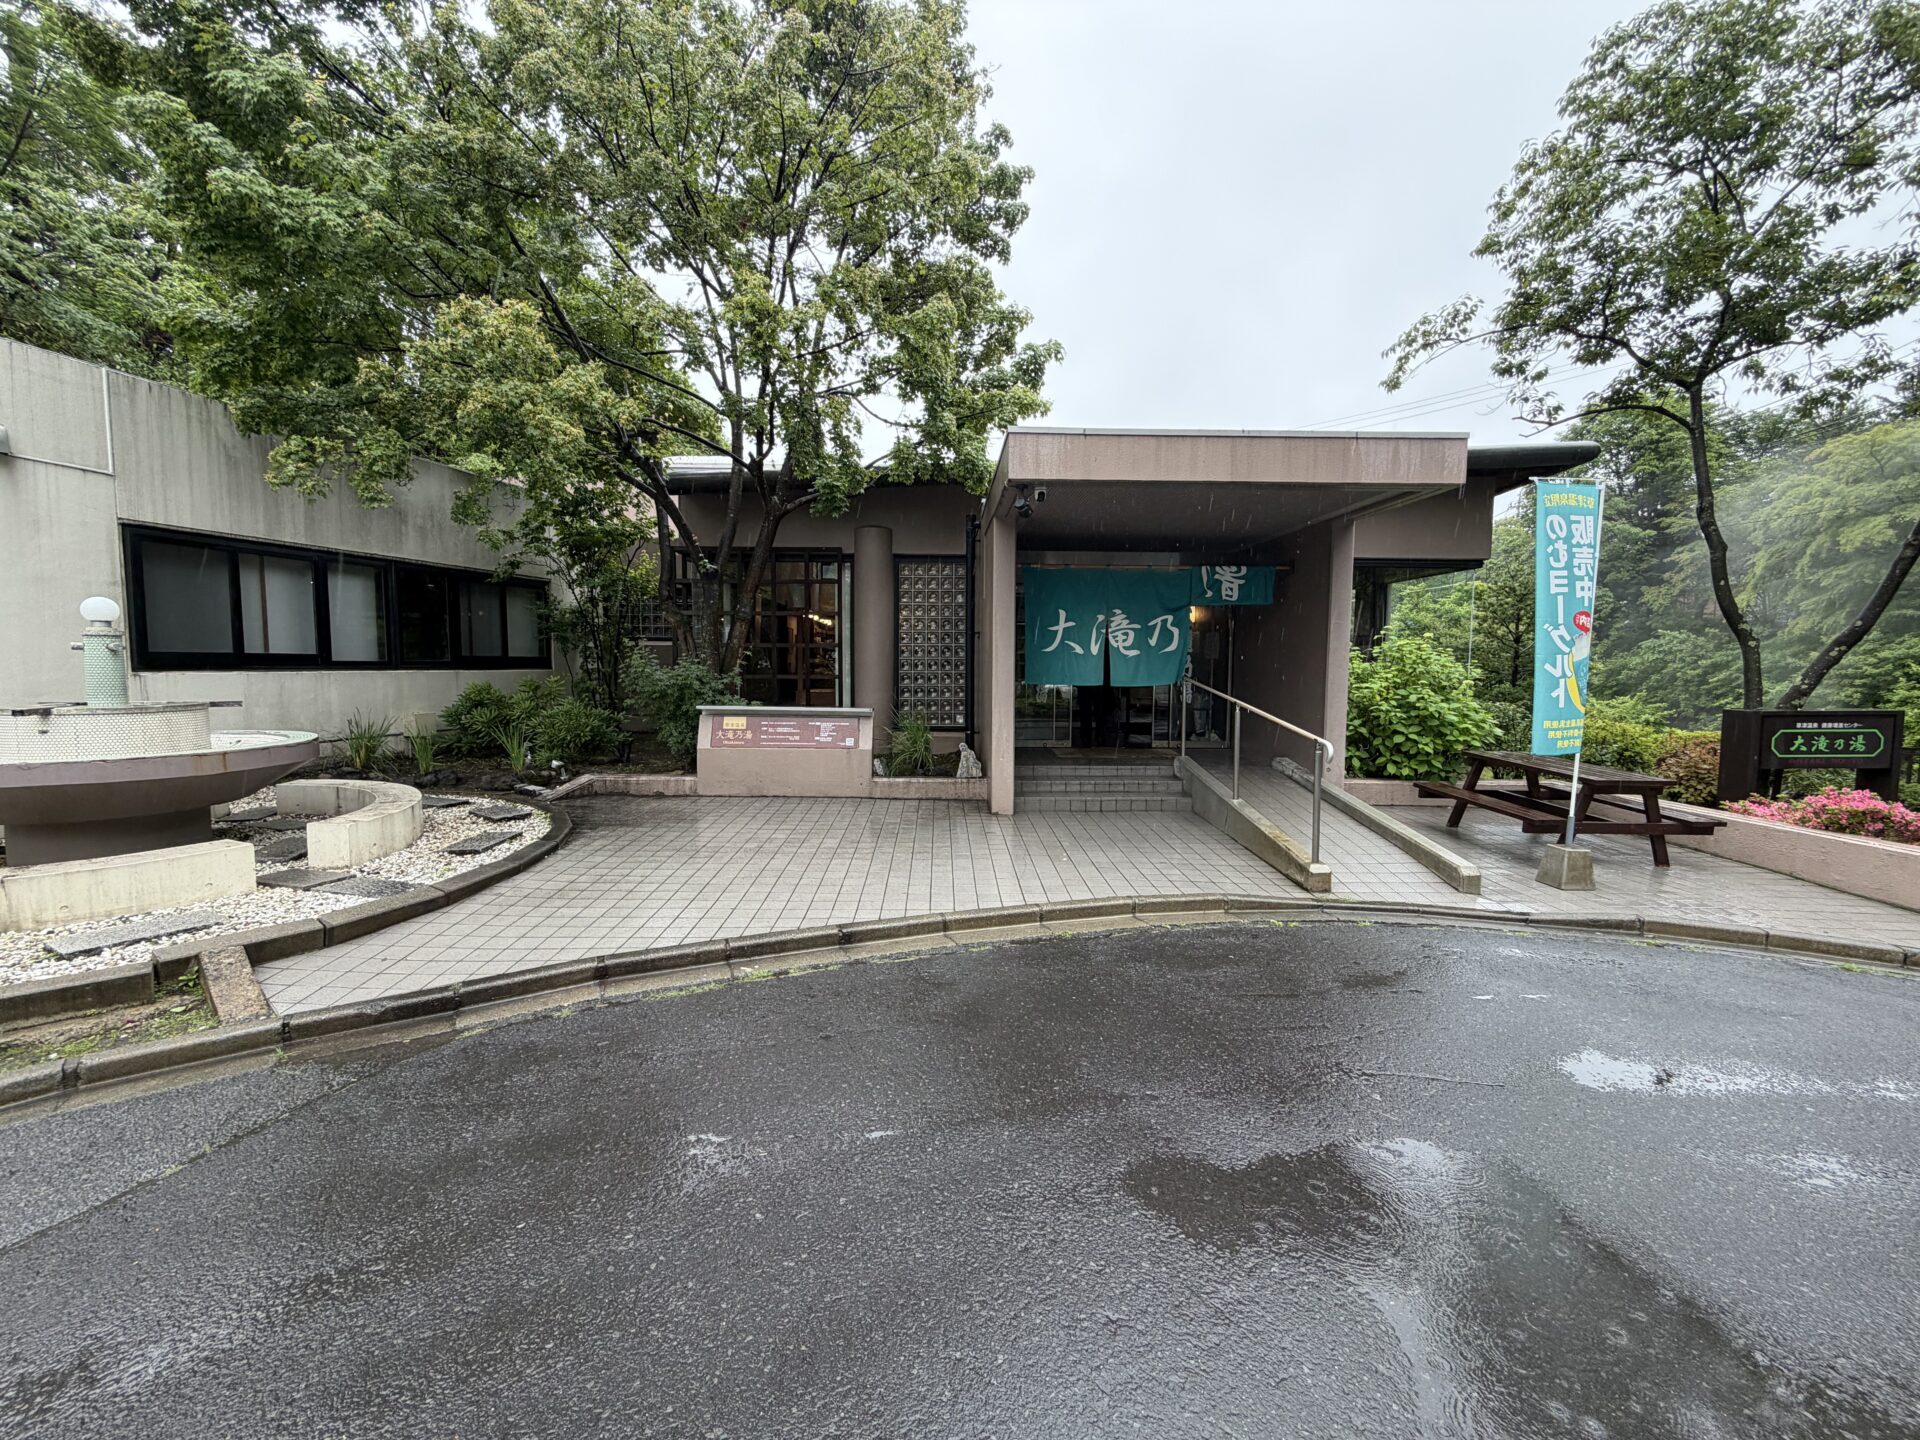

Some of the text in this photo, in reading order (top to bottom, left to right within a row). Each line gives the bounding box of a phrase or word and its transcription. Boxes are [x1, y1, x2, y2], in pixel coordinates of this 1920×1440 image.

[716, 730, 753, 740] 大滝乃湯
[1789, 734, 1867, 752] 大滝乃湯
